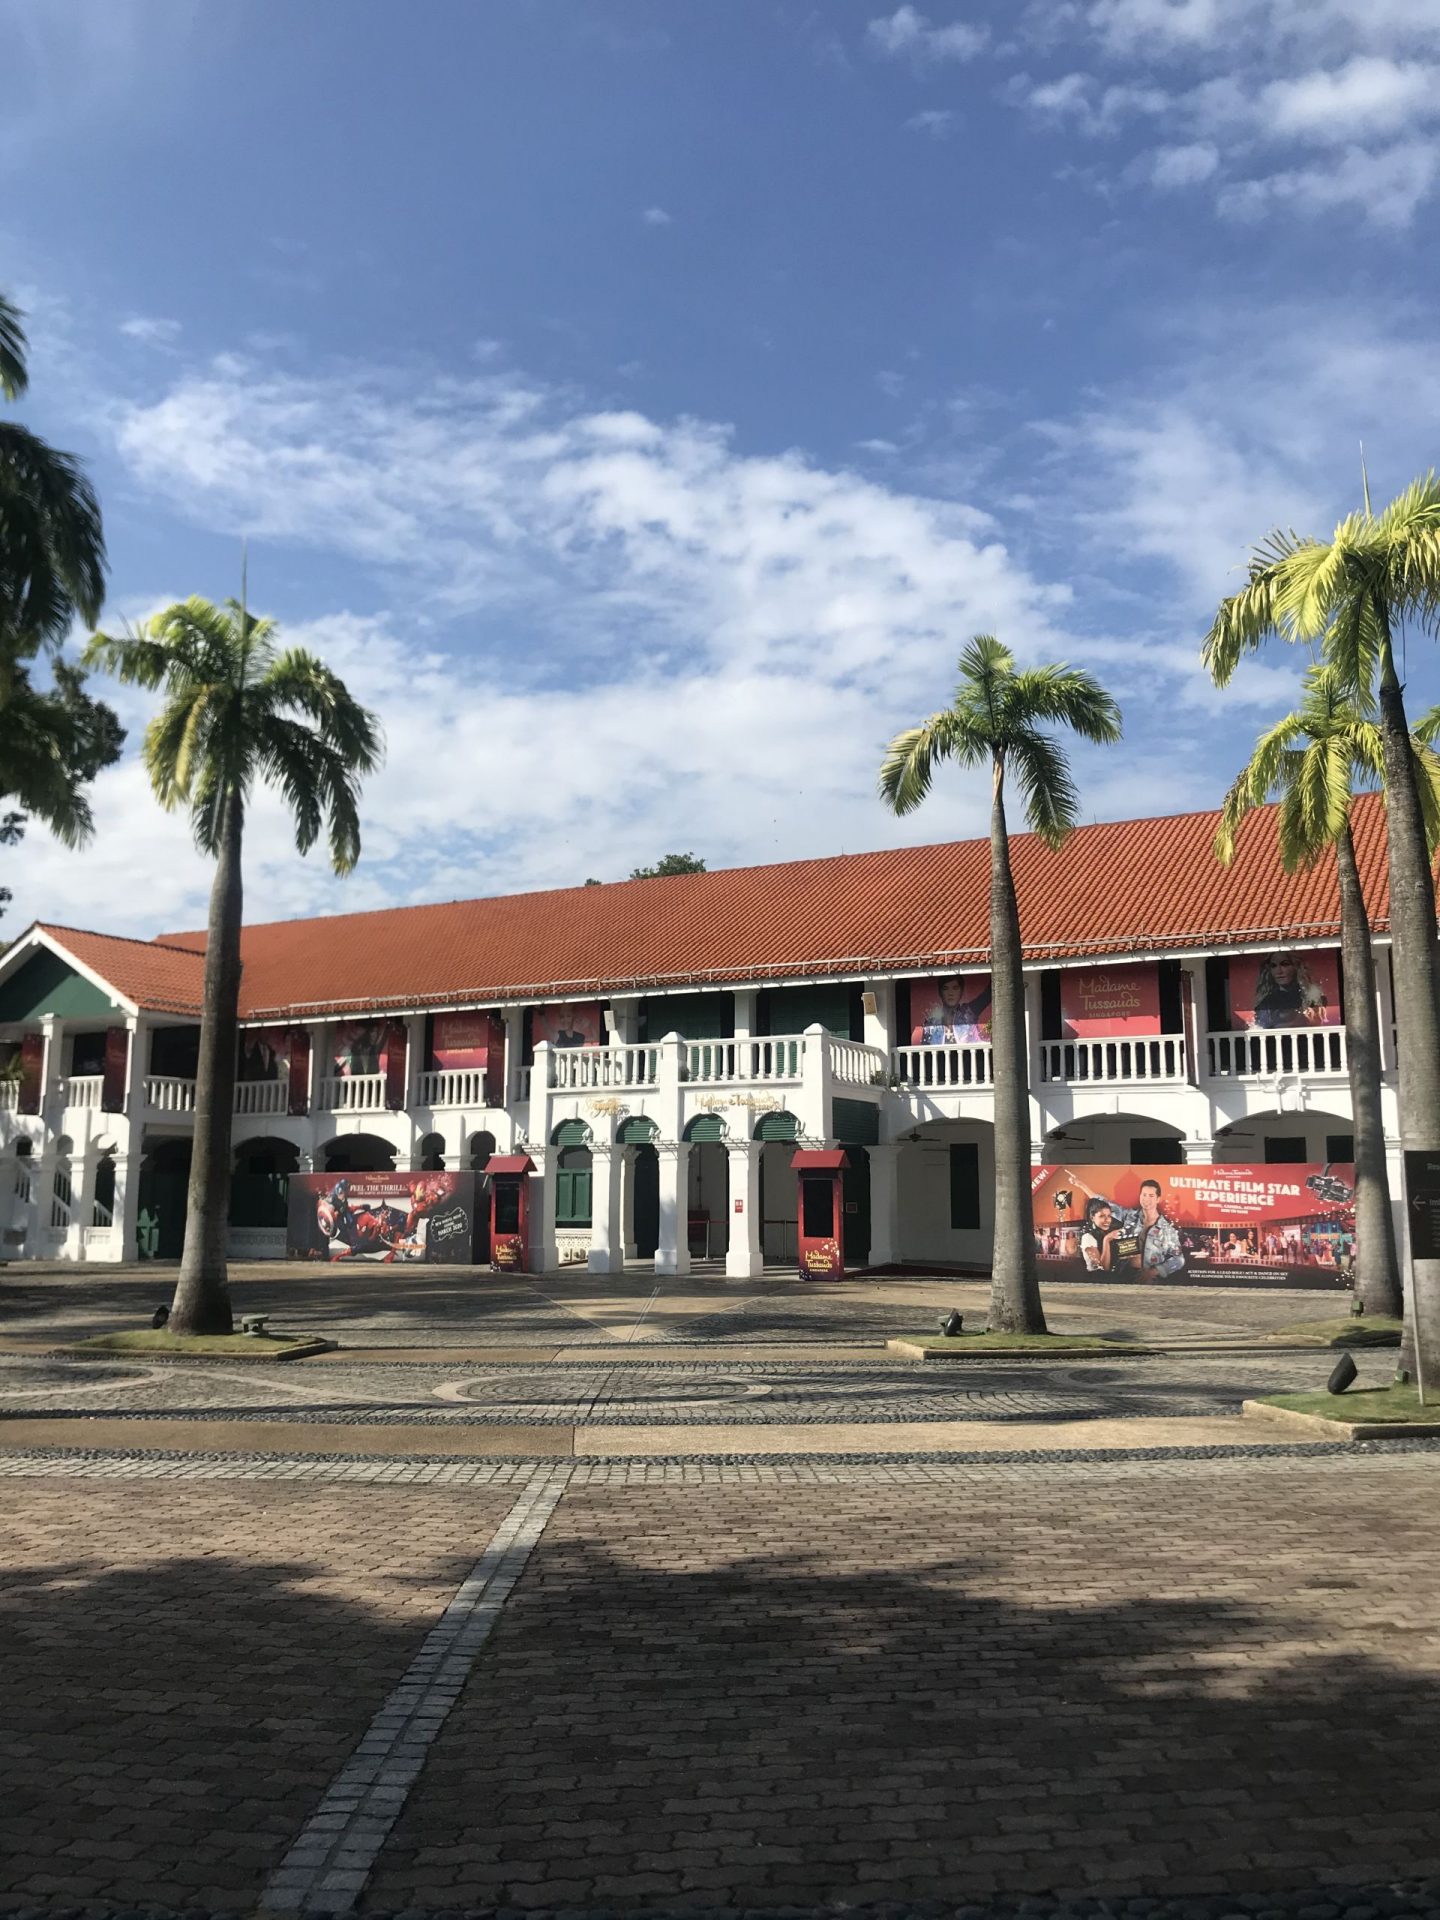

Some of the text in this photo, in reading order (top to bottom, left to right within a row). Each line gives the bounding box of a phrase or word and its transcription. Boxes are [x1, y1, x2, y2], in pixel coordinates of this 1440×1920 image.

[1077, 975, 1141, 995] Madame
[1078, 991, 1141, 1011] Tussauds
[1169, 1176, 1301, 1196] ULTIMATE FILM STAR
[1194, 1190, 1275, 1206] EXPERIENCE
[805, 1250, 833, 1261] Madame
[806, 1259, 833, 1269] Tussauds
